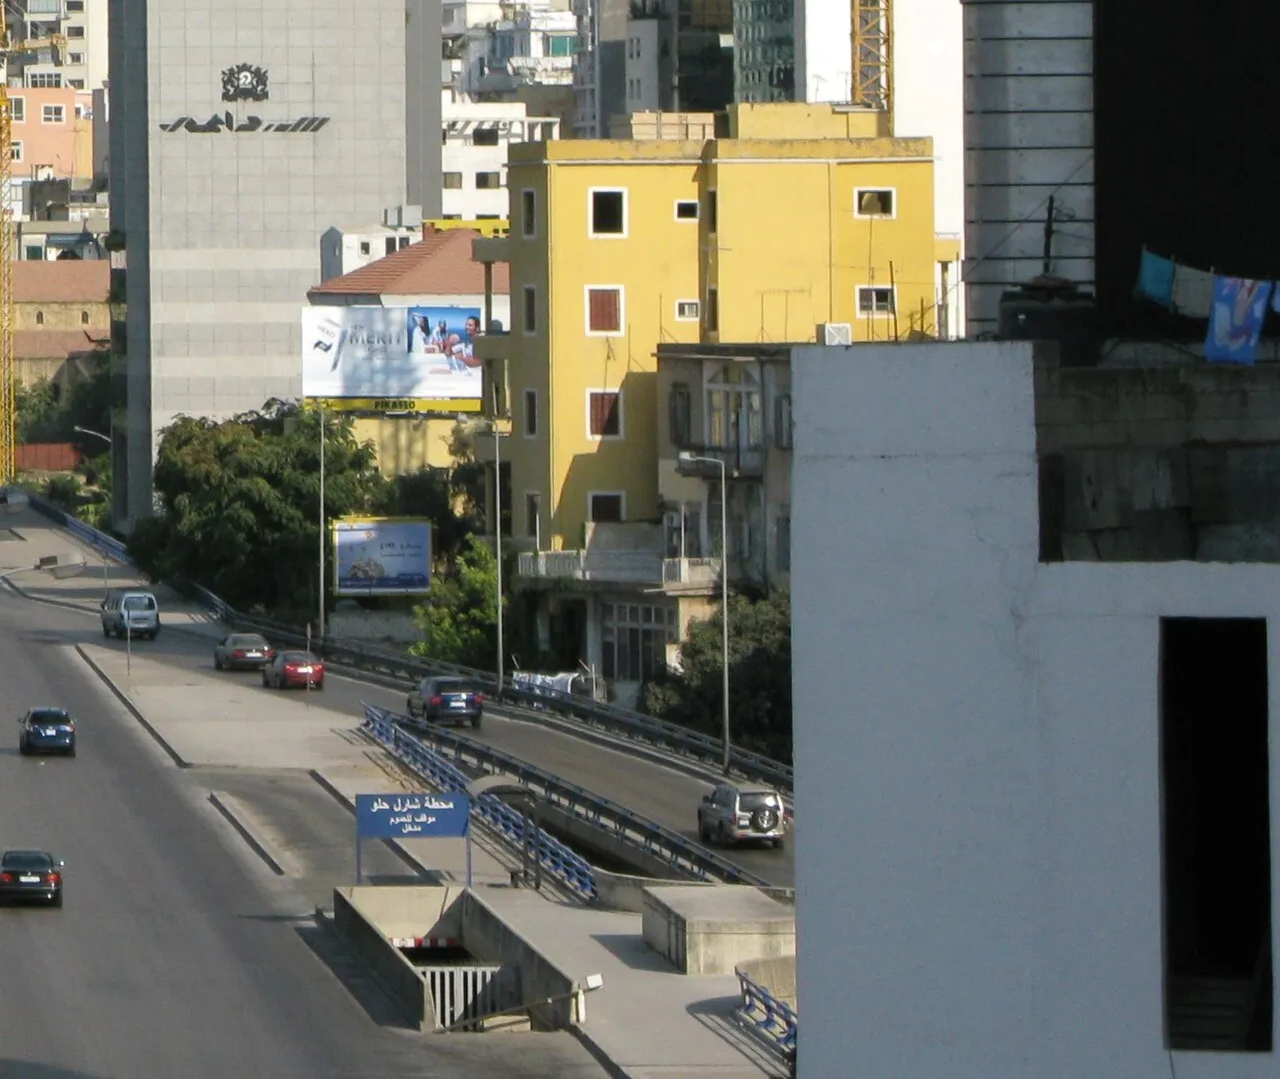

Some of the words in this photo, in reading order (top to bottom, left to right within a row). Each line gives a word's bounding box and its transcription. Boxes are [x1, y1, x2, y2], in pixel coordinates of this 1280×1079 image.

[371, 797, 390, 812] حلو
[393, 797, 421, 812] شارل
[424, 796, 454, 809] محطة
